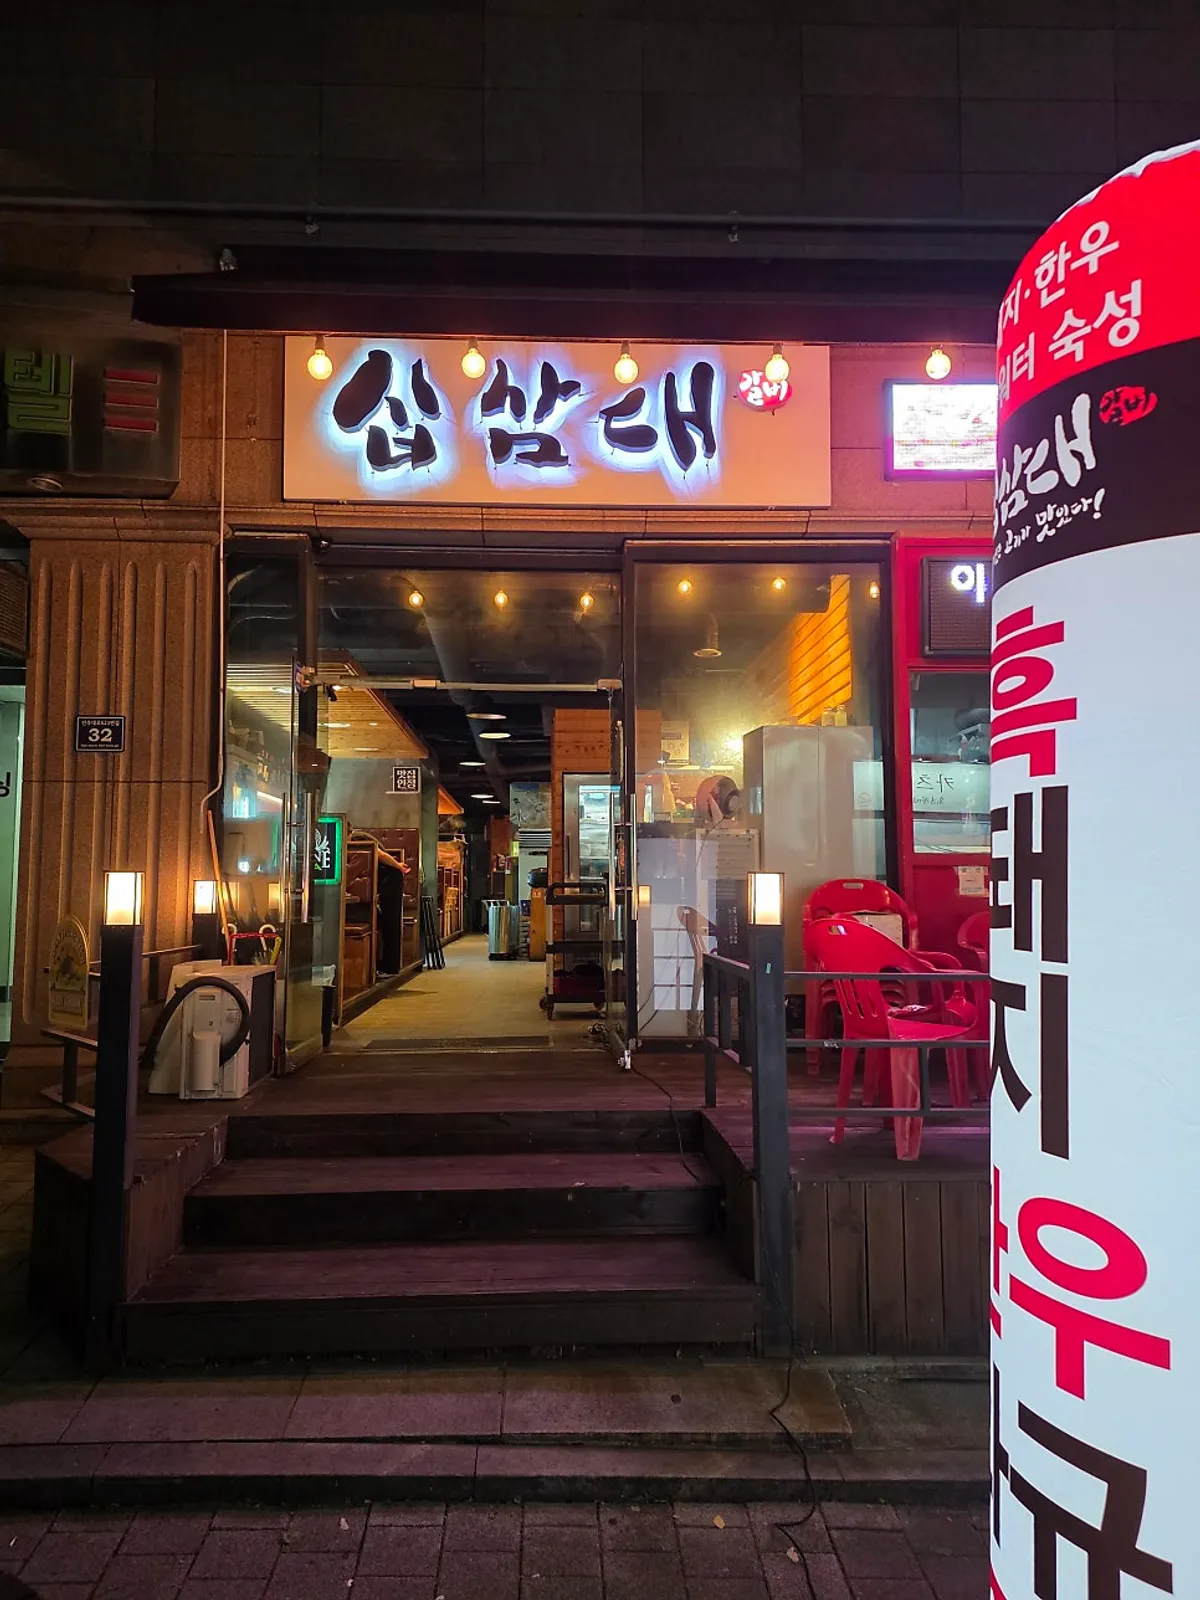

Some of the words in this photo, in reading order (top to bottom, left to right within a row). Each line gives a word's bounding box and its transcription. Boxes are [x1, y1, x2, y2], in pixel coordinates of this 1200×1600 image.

[1048, 279, 1143, 363] 숙성
[331, 348, 717, 473] 십삼대
[739, 369, 789, 407] 갈비
[993, 393, 1097, 538] 삼대
[1035, 487, 1106, 543] 맛있다!
[88, 727, 113, 742] 32
